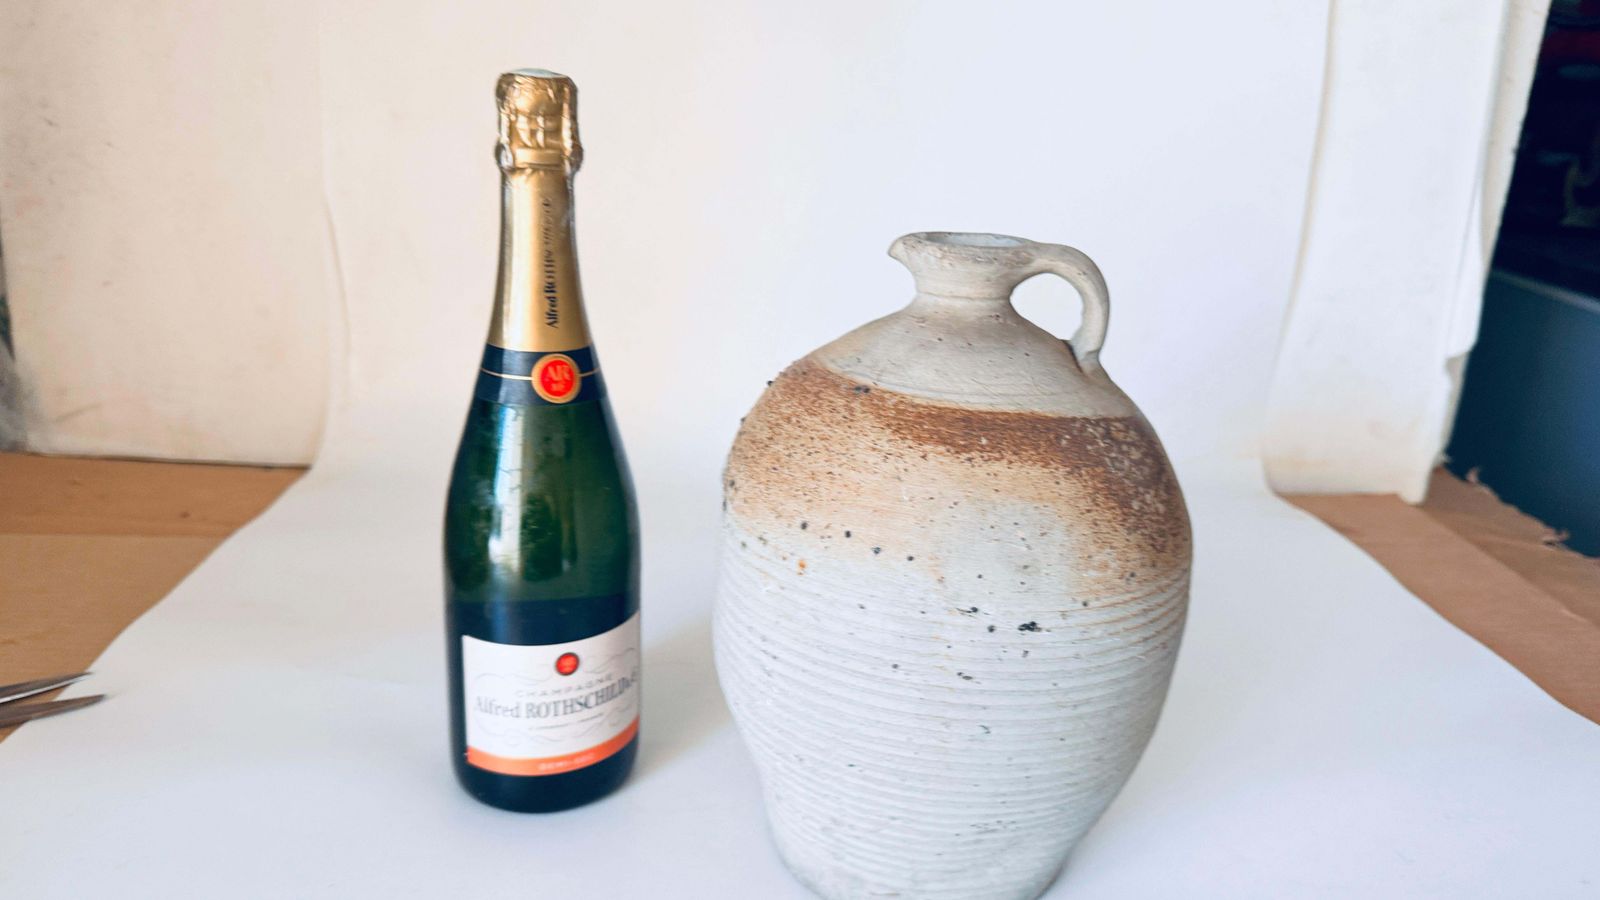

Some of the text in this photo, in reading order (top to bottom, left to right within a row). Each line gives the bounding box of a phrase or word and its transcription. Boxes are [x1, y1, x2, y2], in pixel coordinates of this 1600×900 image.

[544, 296, 559, 329] Alfred
[473, 695, 521, 719] Alfred
[526, 677, 625, 719] ROTHSCHILD
